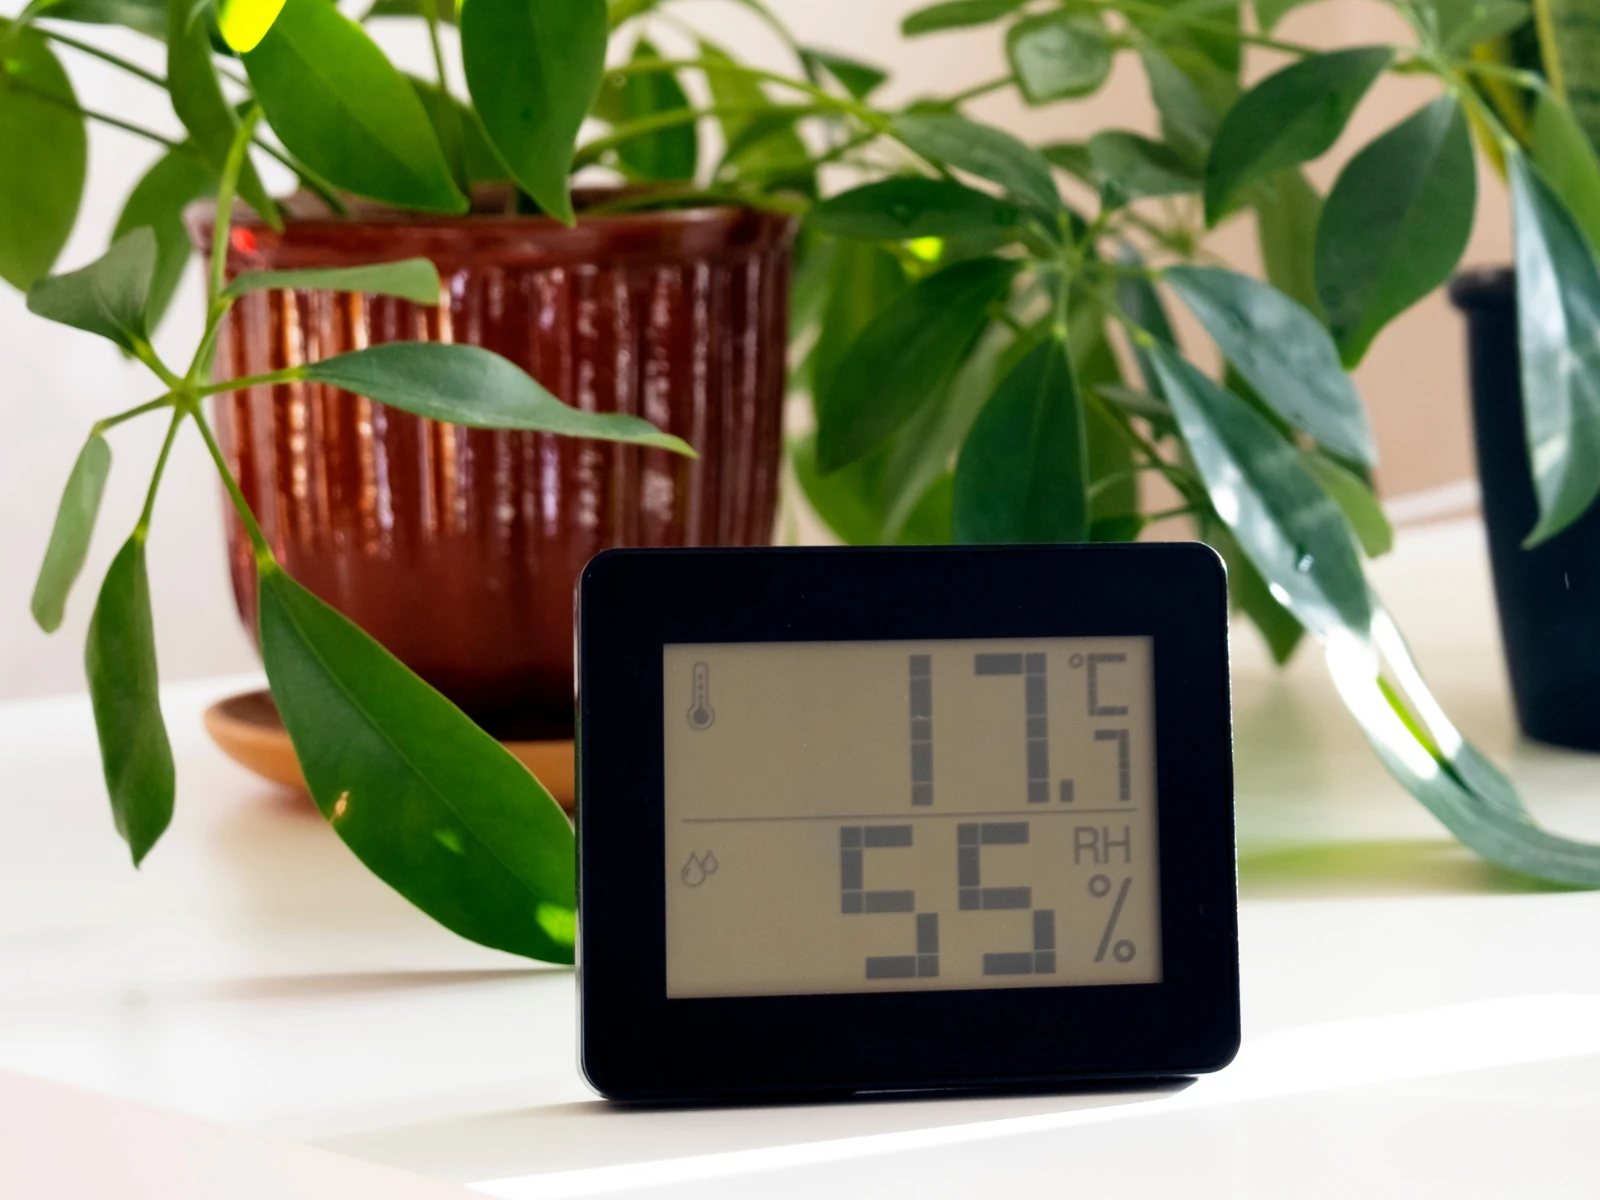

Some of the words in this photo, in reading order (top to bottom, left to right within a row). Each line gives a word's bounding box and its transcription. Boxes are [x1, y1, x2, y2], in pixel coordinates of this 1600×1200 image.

[1073, 825, 1132, 866] RH
[840, 821, 1057, 980] 55
[1088, 873, 1137, 964] %
